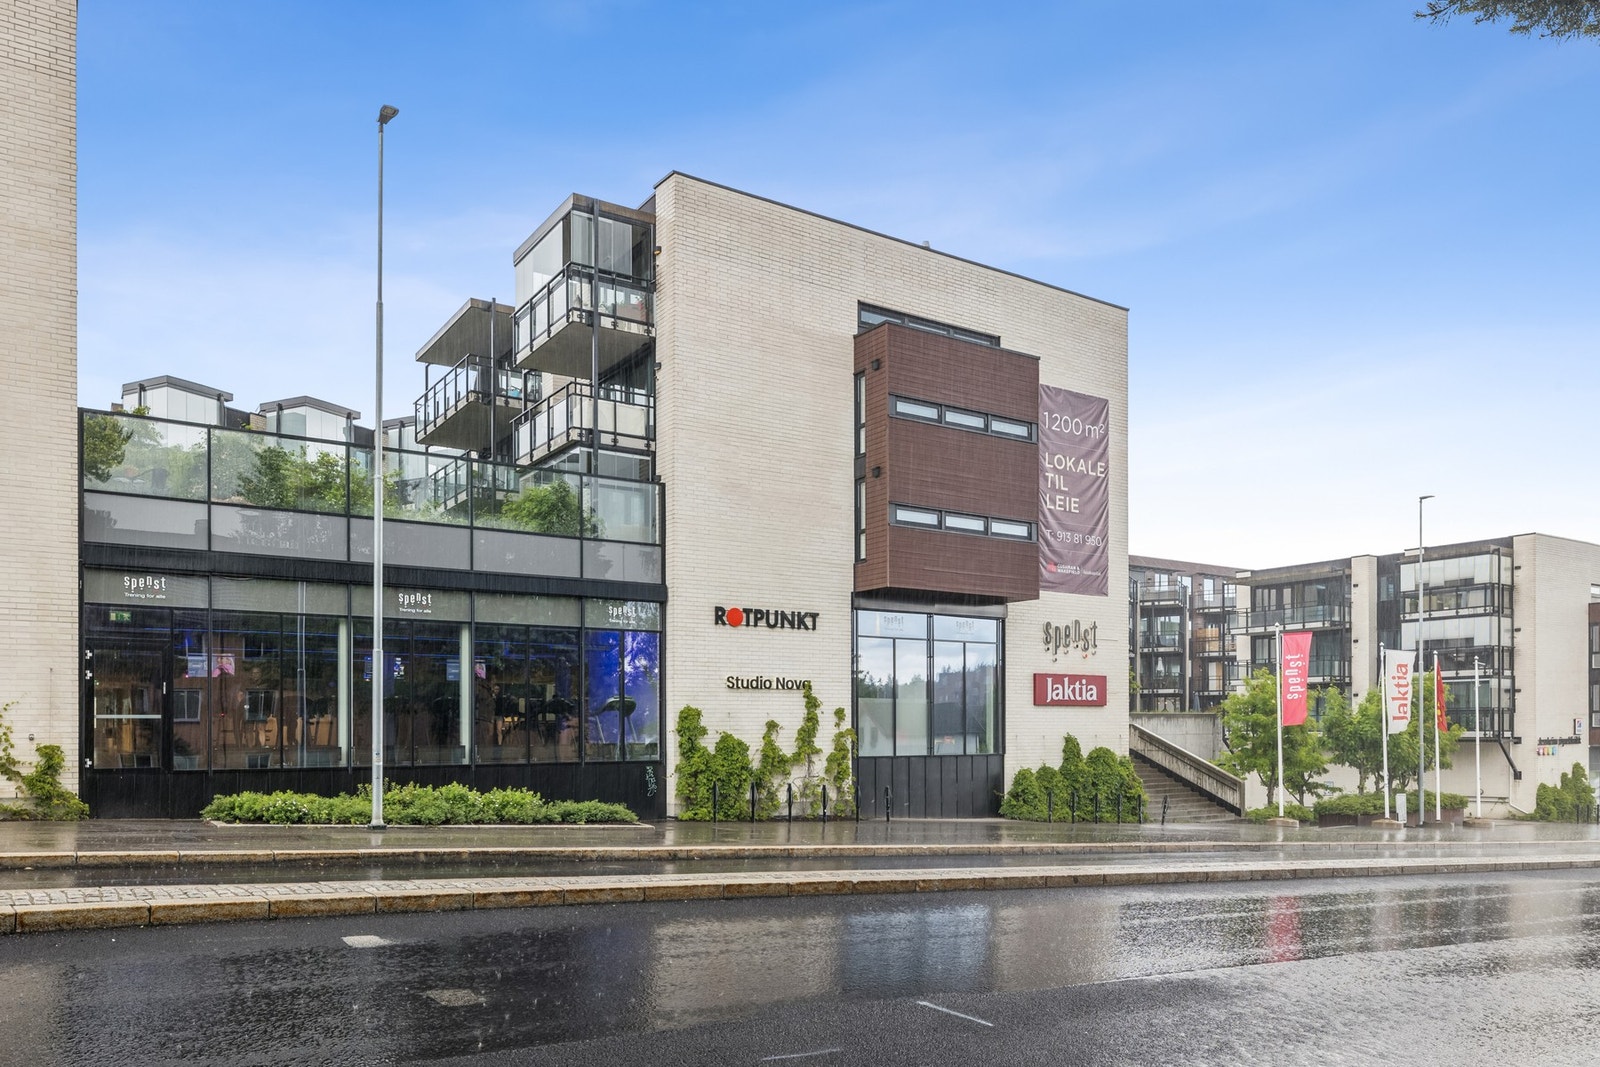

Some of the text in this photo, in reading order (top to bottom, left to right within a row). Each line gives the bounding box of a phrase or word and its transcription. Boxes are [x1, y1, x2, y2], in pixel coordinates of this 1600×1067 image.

[1043, 411, 1083, 436] 1200
[1045, 452, 1106, 478] LOKALE
[1045, 472, 1069, 491] TIL
[1046, 493, 1080, 513] LEIE
[1056, 530, 1072, 543] 913
[1073, 533, 1083, 544] 81
[1084, 534, 1102, 547] 950
[124, 576, 166, 592] spenst
[398, 592, 432, 607] spenst
[714, 606, 820, 631] ROTPUNKT
[1043, 619, 1098, 660] spenst
[726, 675, 773, 690] Studio
[1046, 676, 1098, 703] Jaktia
[1391, 663, 1410, 722] Jaktia
